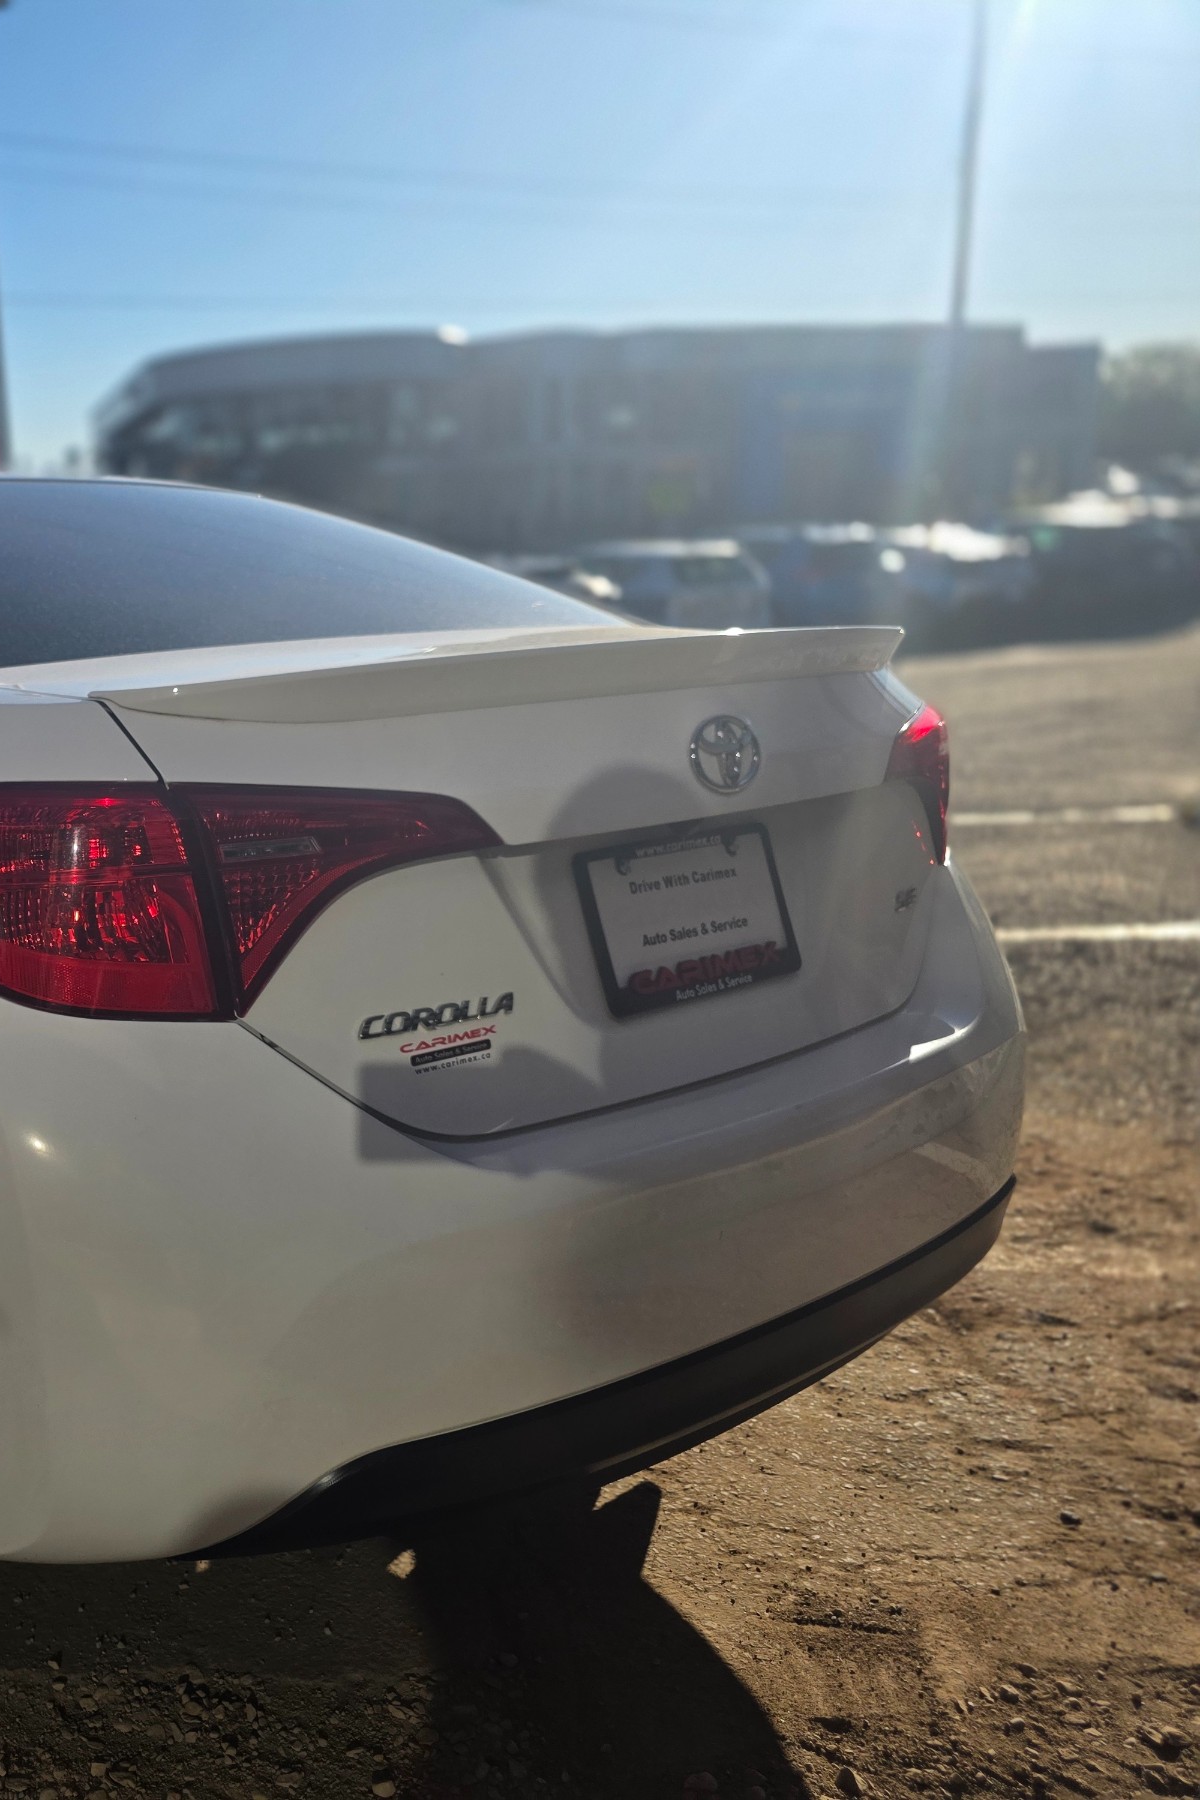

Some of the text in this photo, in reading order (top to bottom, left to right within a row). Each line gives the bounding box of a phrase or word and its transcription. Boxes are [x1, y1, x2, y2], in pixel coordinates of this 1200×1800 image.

[629, 867, 737, 895] Drive With Carimex
[642, 916, 749, 947] Auto Sales & Service
[630, 940, 781, 995] CARIMEX
[675, 972, 753, 1002] Auto Sales & Service
[358, 991, 514, 1040] COROLLA
[400, 1024, 497, 1053] CARIMEX
[414, 1053, 491, 1075] www.carimex.ca
[415, 1053, 433, 1064] Auto
